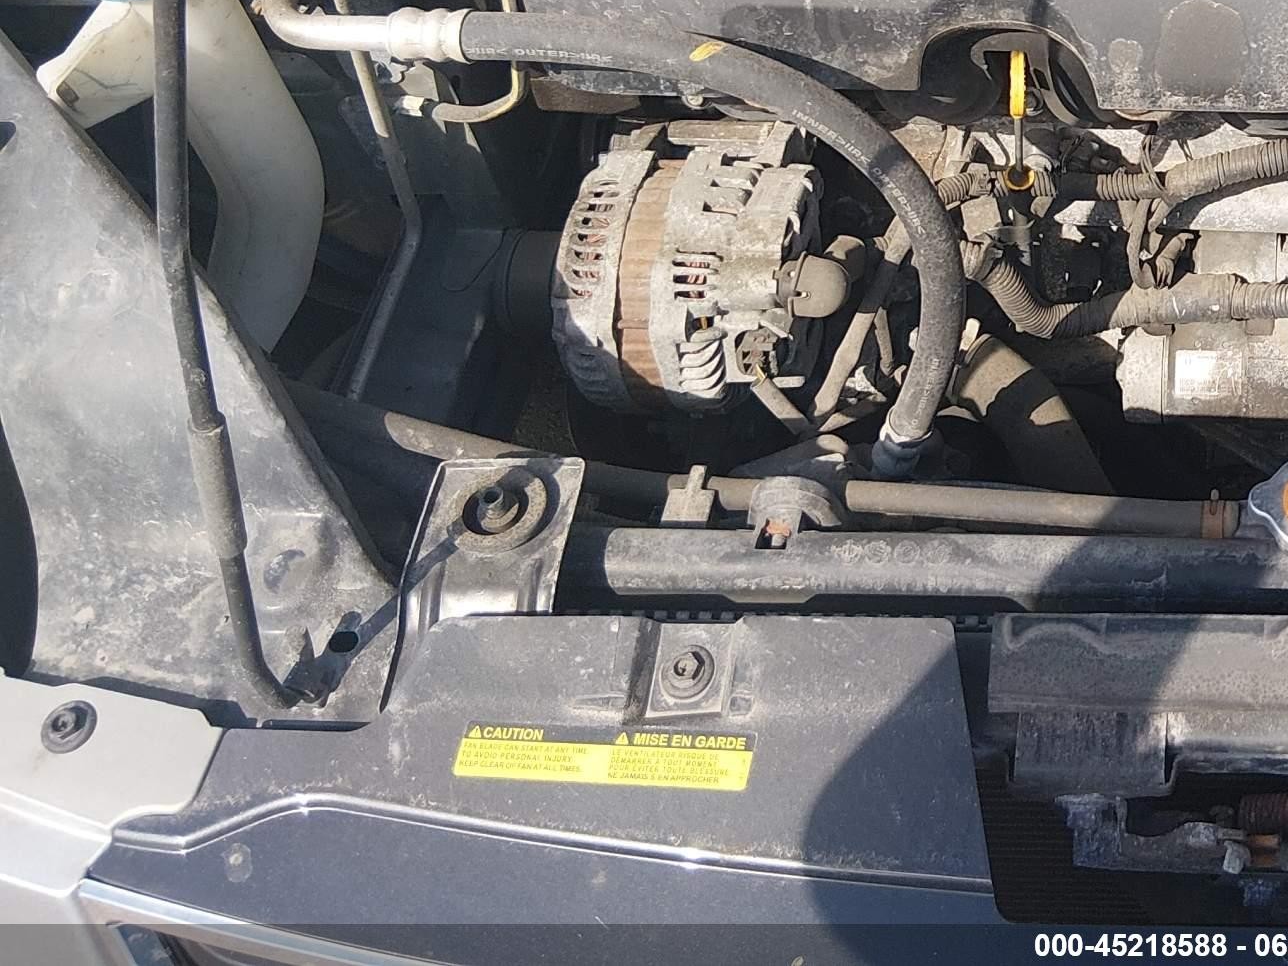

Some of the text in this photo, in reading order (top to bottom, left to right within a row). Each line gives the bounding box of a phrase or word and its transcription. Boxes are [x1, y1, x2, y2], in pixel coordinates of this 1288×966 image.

[483, 726, 544, 740] CAUTION
[633, 733, 747, 749] MISE EN GARDE
